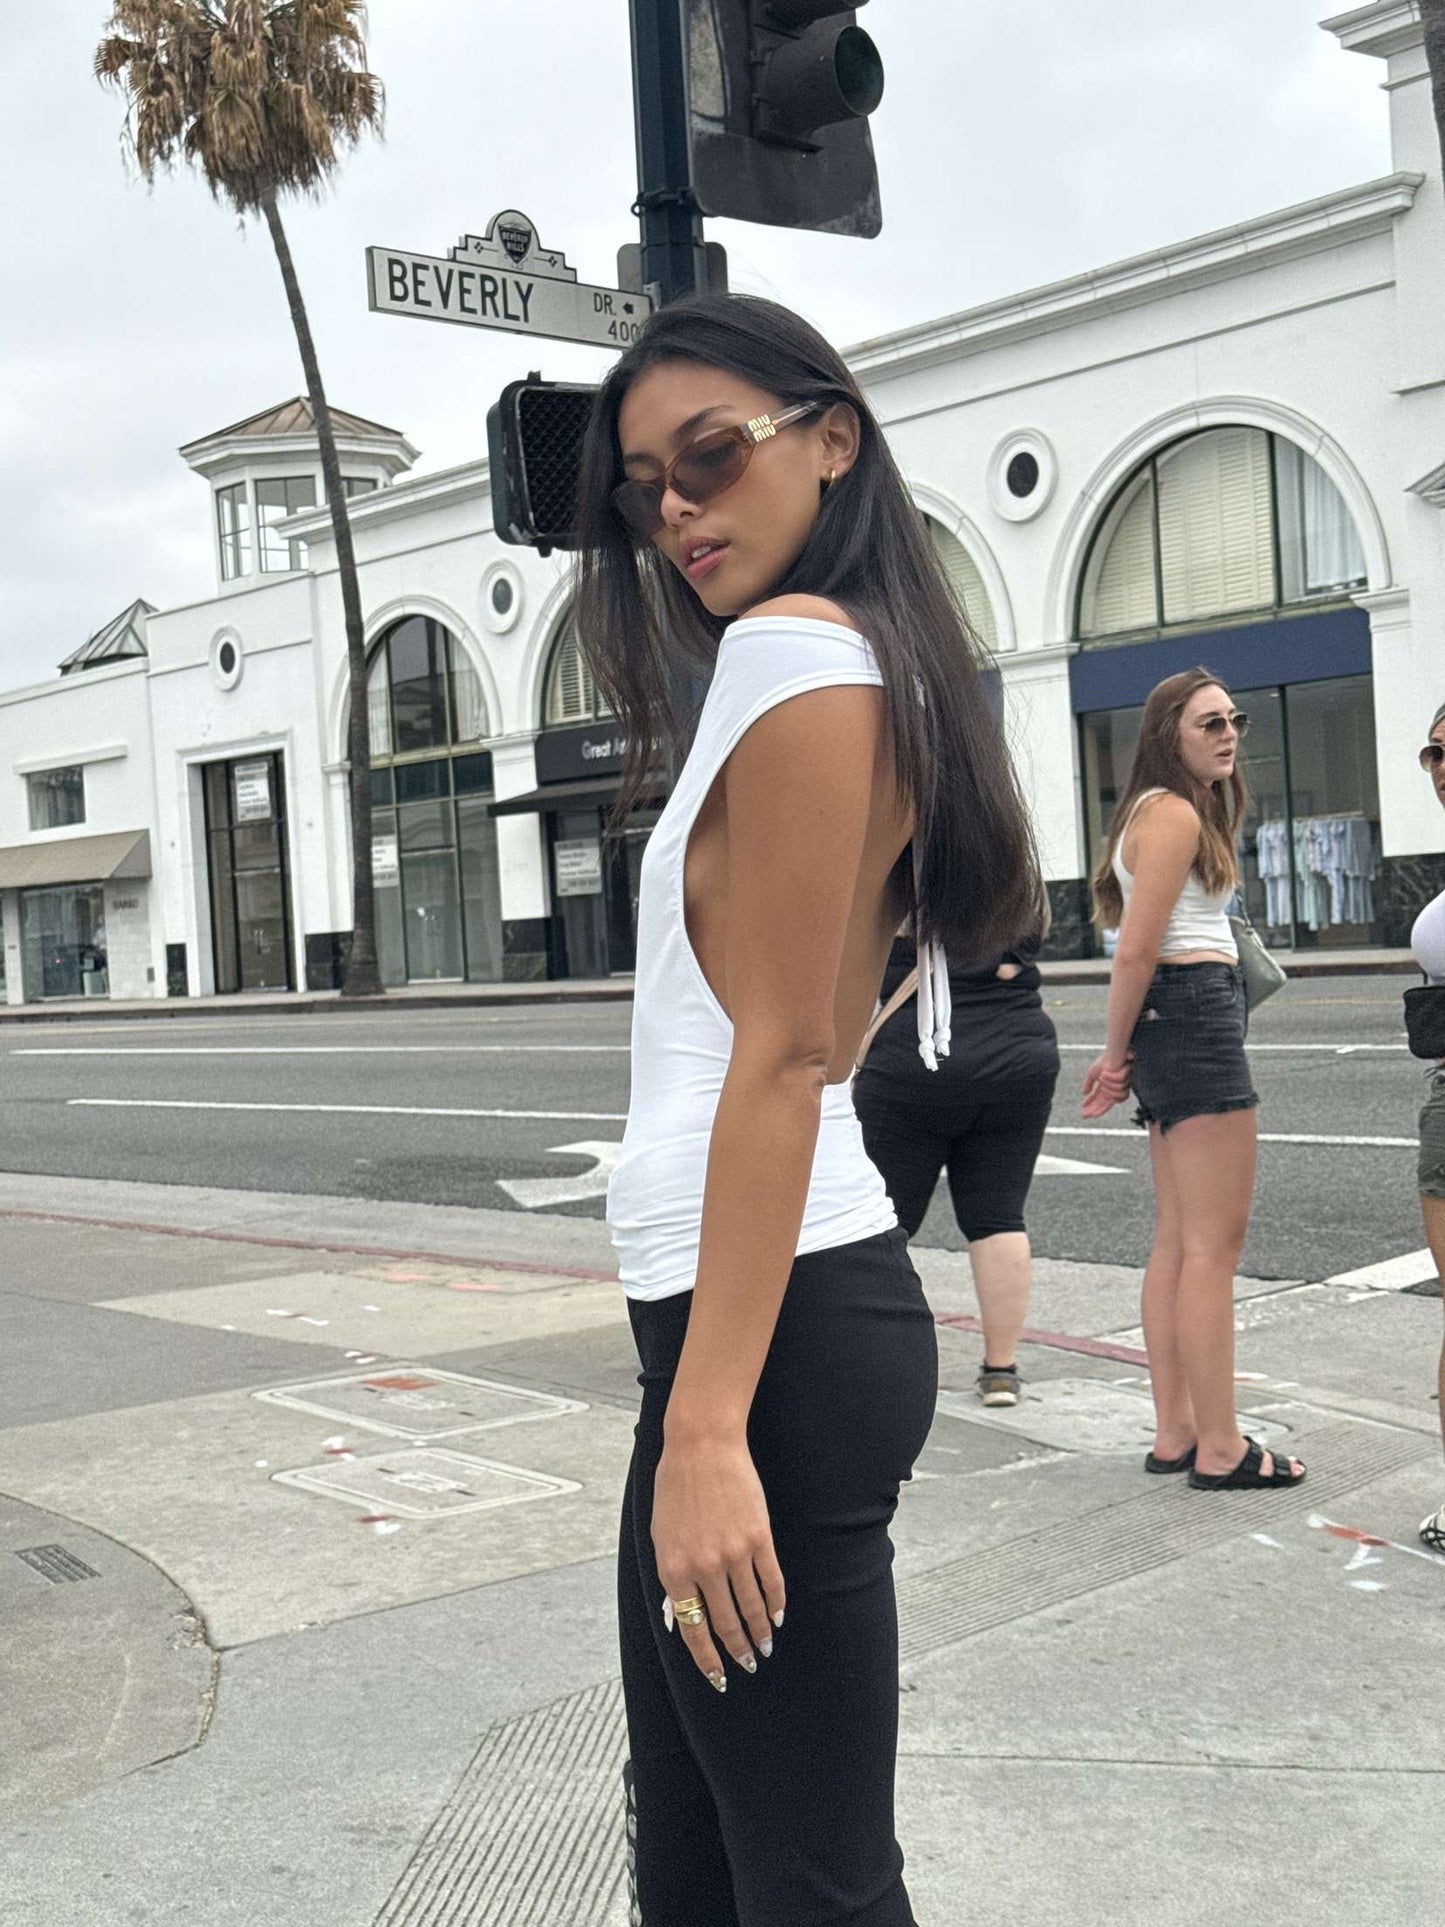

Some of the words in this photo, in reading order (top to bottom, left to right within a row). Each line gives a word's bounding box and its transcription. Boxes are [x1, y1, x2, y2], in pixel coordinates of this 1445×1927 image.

[386, 257, 534, 323] BEVERLY
[593, 292, 617, 316] DR.
[582, 740, 611, 759] Great
